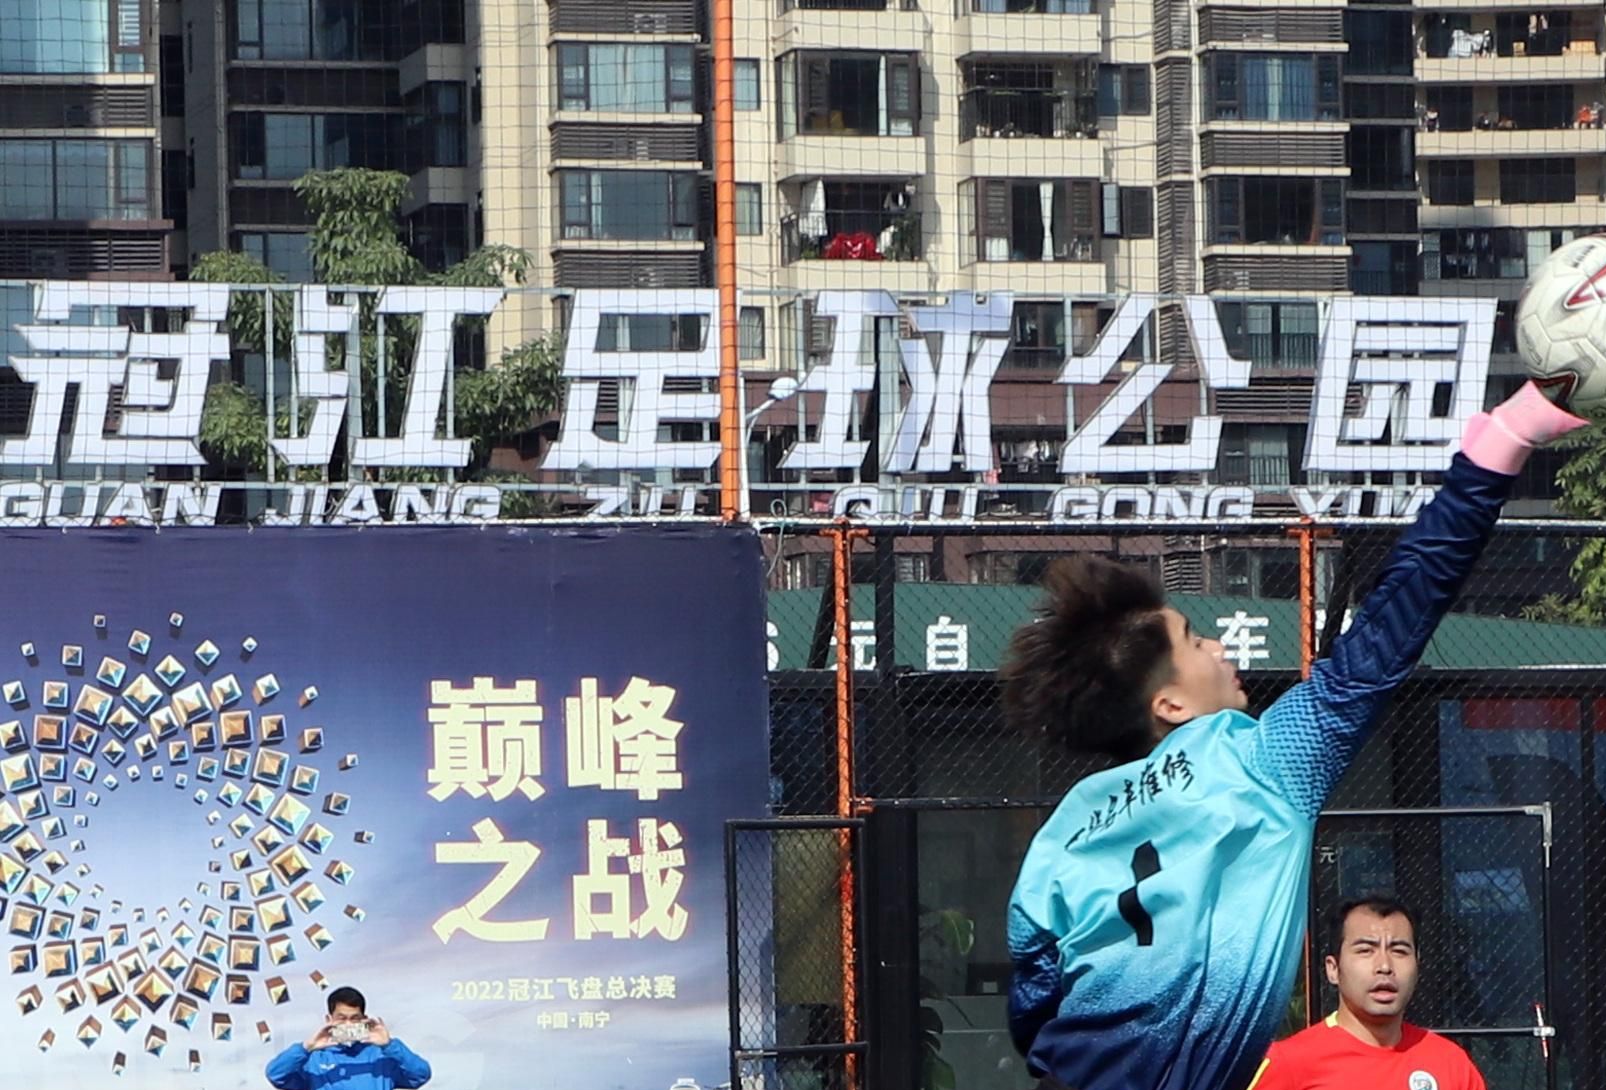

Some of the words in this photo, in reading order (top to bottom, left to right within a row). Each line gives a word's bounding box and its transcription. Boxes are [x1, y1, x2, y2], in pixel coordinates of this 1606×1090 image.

[2, 280, 1498, 474] 冠江足球公园
[0, 482, 221, 527] GUAN
[262, 483, 501, 526] JIANG
[580, 485, 705, 518] ZU
[832, 486, 977, 521] QIU
[1048, 486, 1255, 522] GONG
[1290, 486, 1437, 517] YUA
[426, 676, 686, 804] 巅峰
[432, 817, 690, 945] 之战
[451, 975, 677, 1001] 2022冠江飞盘总决赛
[536, 1010, 611, 1031] 中国·南宁
